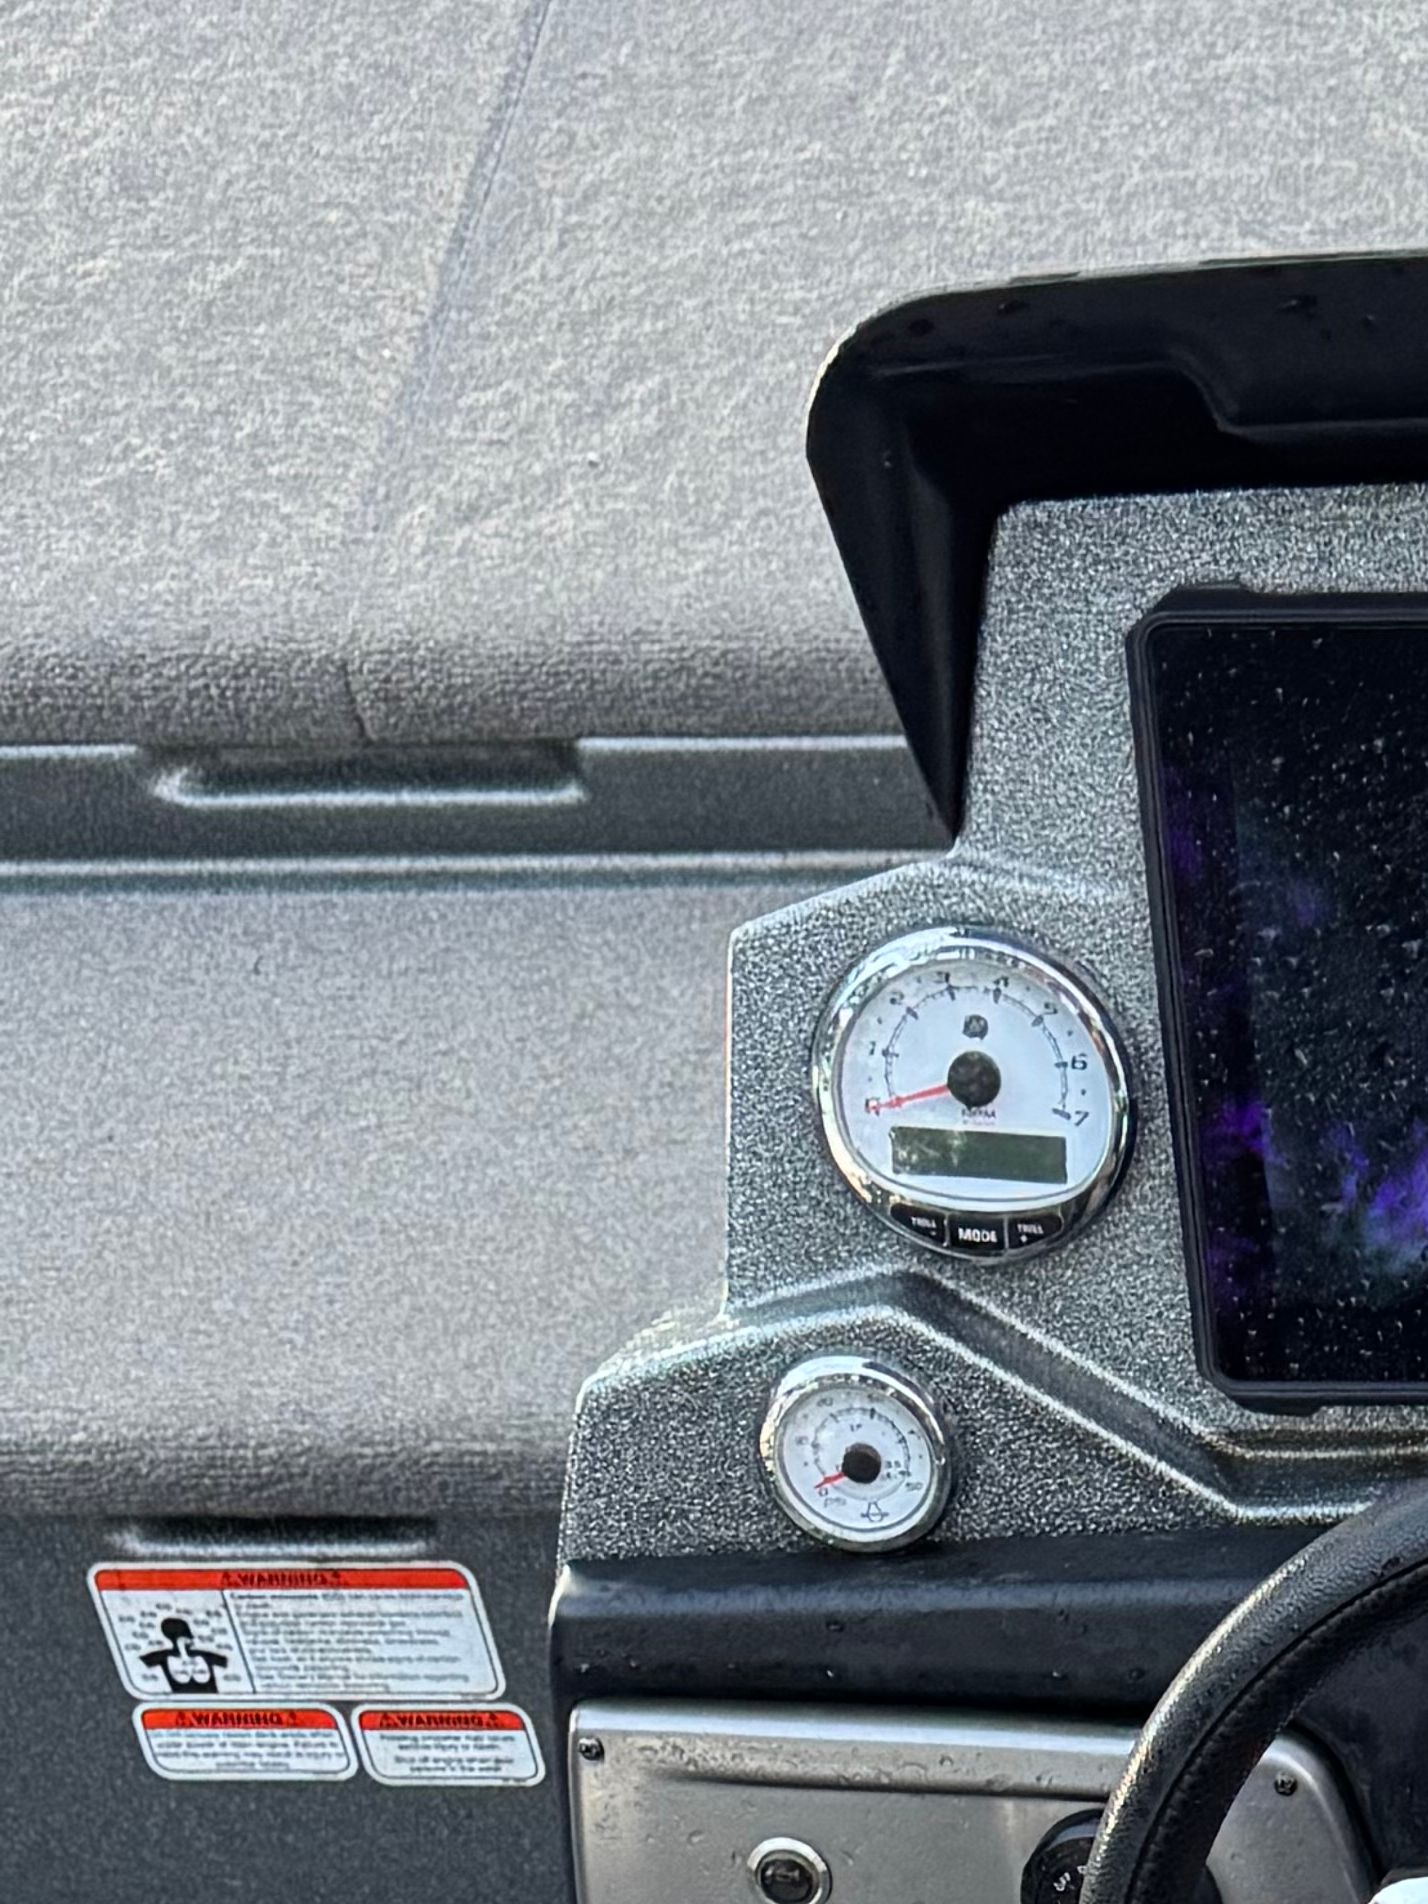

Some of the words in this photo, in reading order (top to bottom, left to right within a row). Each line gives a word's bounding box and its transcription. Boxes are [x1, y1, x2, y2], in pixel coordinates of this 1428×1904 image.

[1071, 1053, 1088, 1071] 6
[1074, 1110, 1089, 1127] 7
[236, 1571, 328, 1587] WARNING
[188, 1711, 282, 1727] WARNING
[397, 1714, 484, 1727] WARNING
